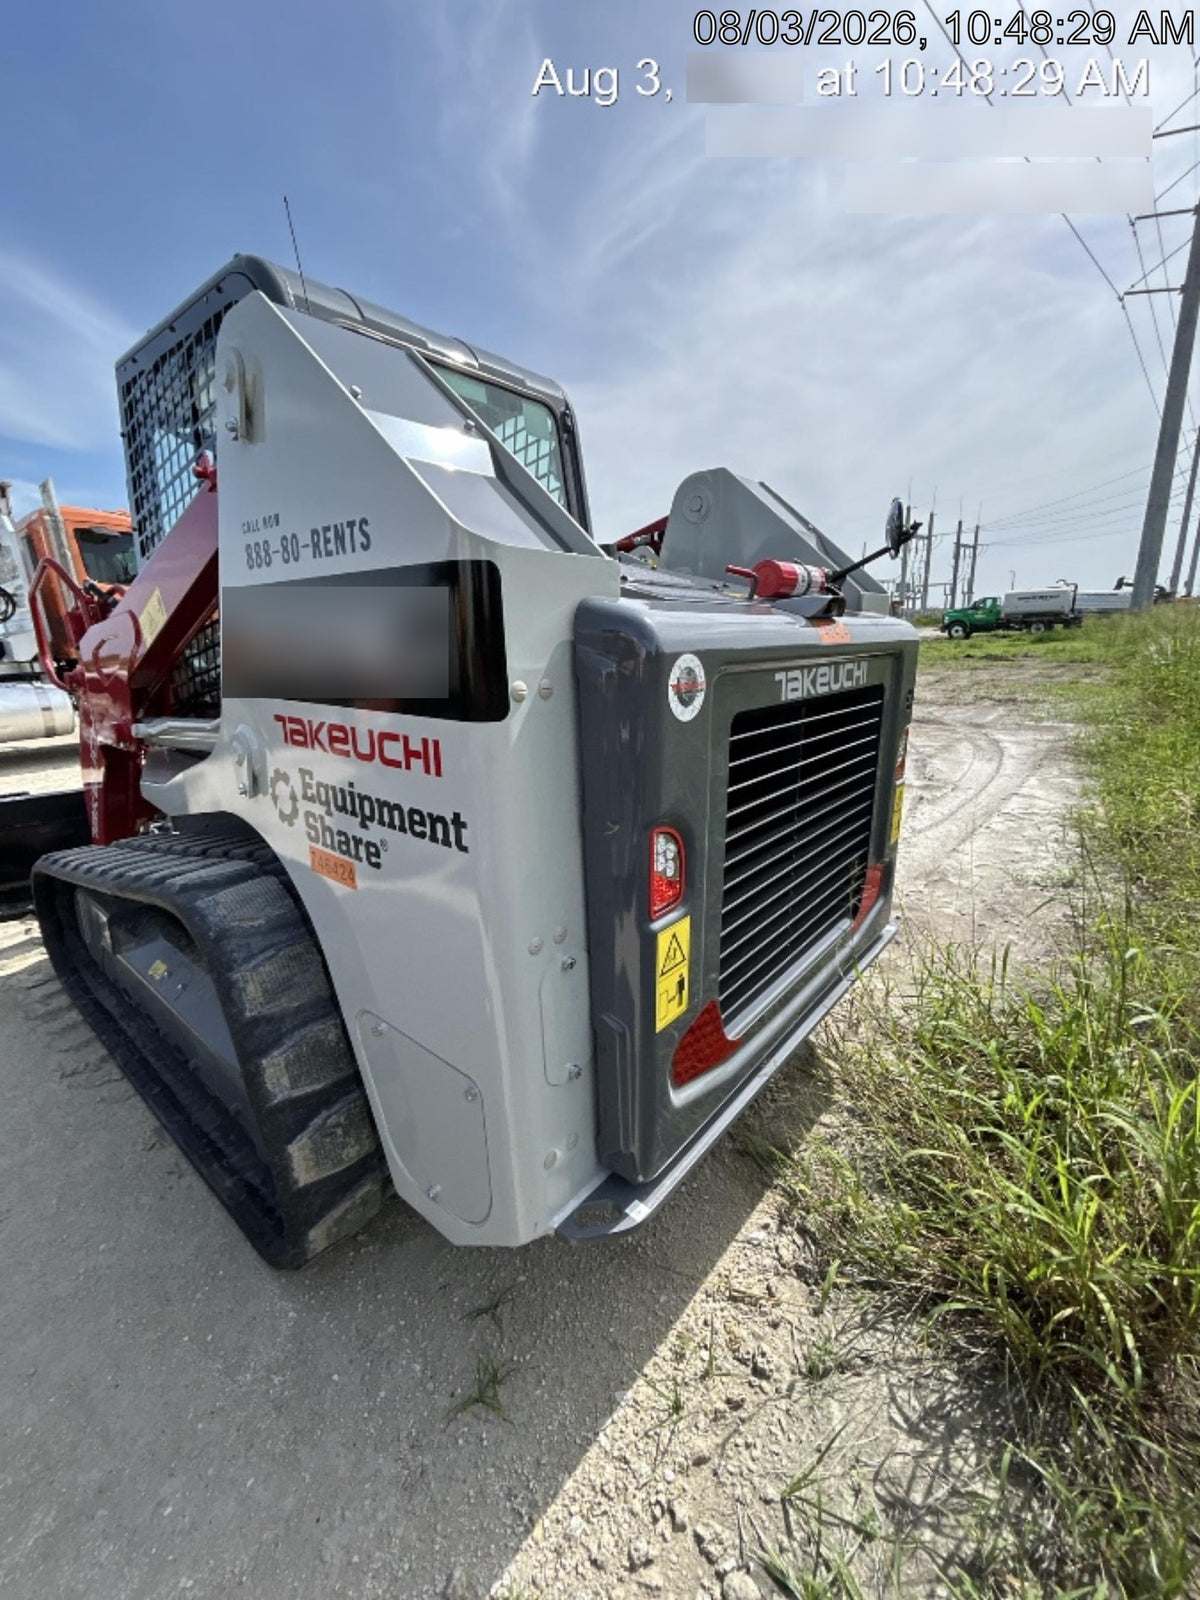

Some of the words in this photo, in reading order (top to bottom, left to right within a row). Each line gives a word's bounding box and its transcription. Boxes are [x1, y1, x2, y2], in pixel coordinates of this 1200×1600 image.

[241, 518, 260, 534] CALL
[262, 512, 280, 529] NOW
[245, 517, 371, 570] 888-80-RENTS
[774, 660, 868, 701] TAKEUCHI
[273, 714, 443, 777] TAKEUCHI
[298, 767, 469, 853] Equipment
